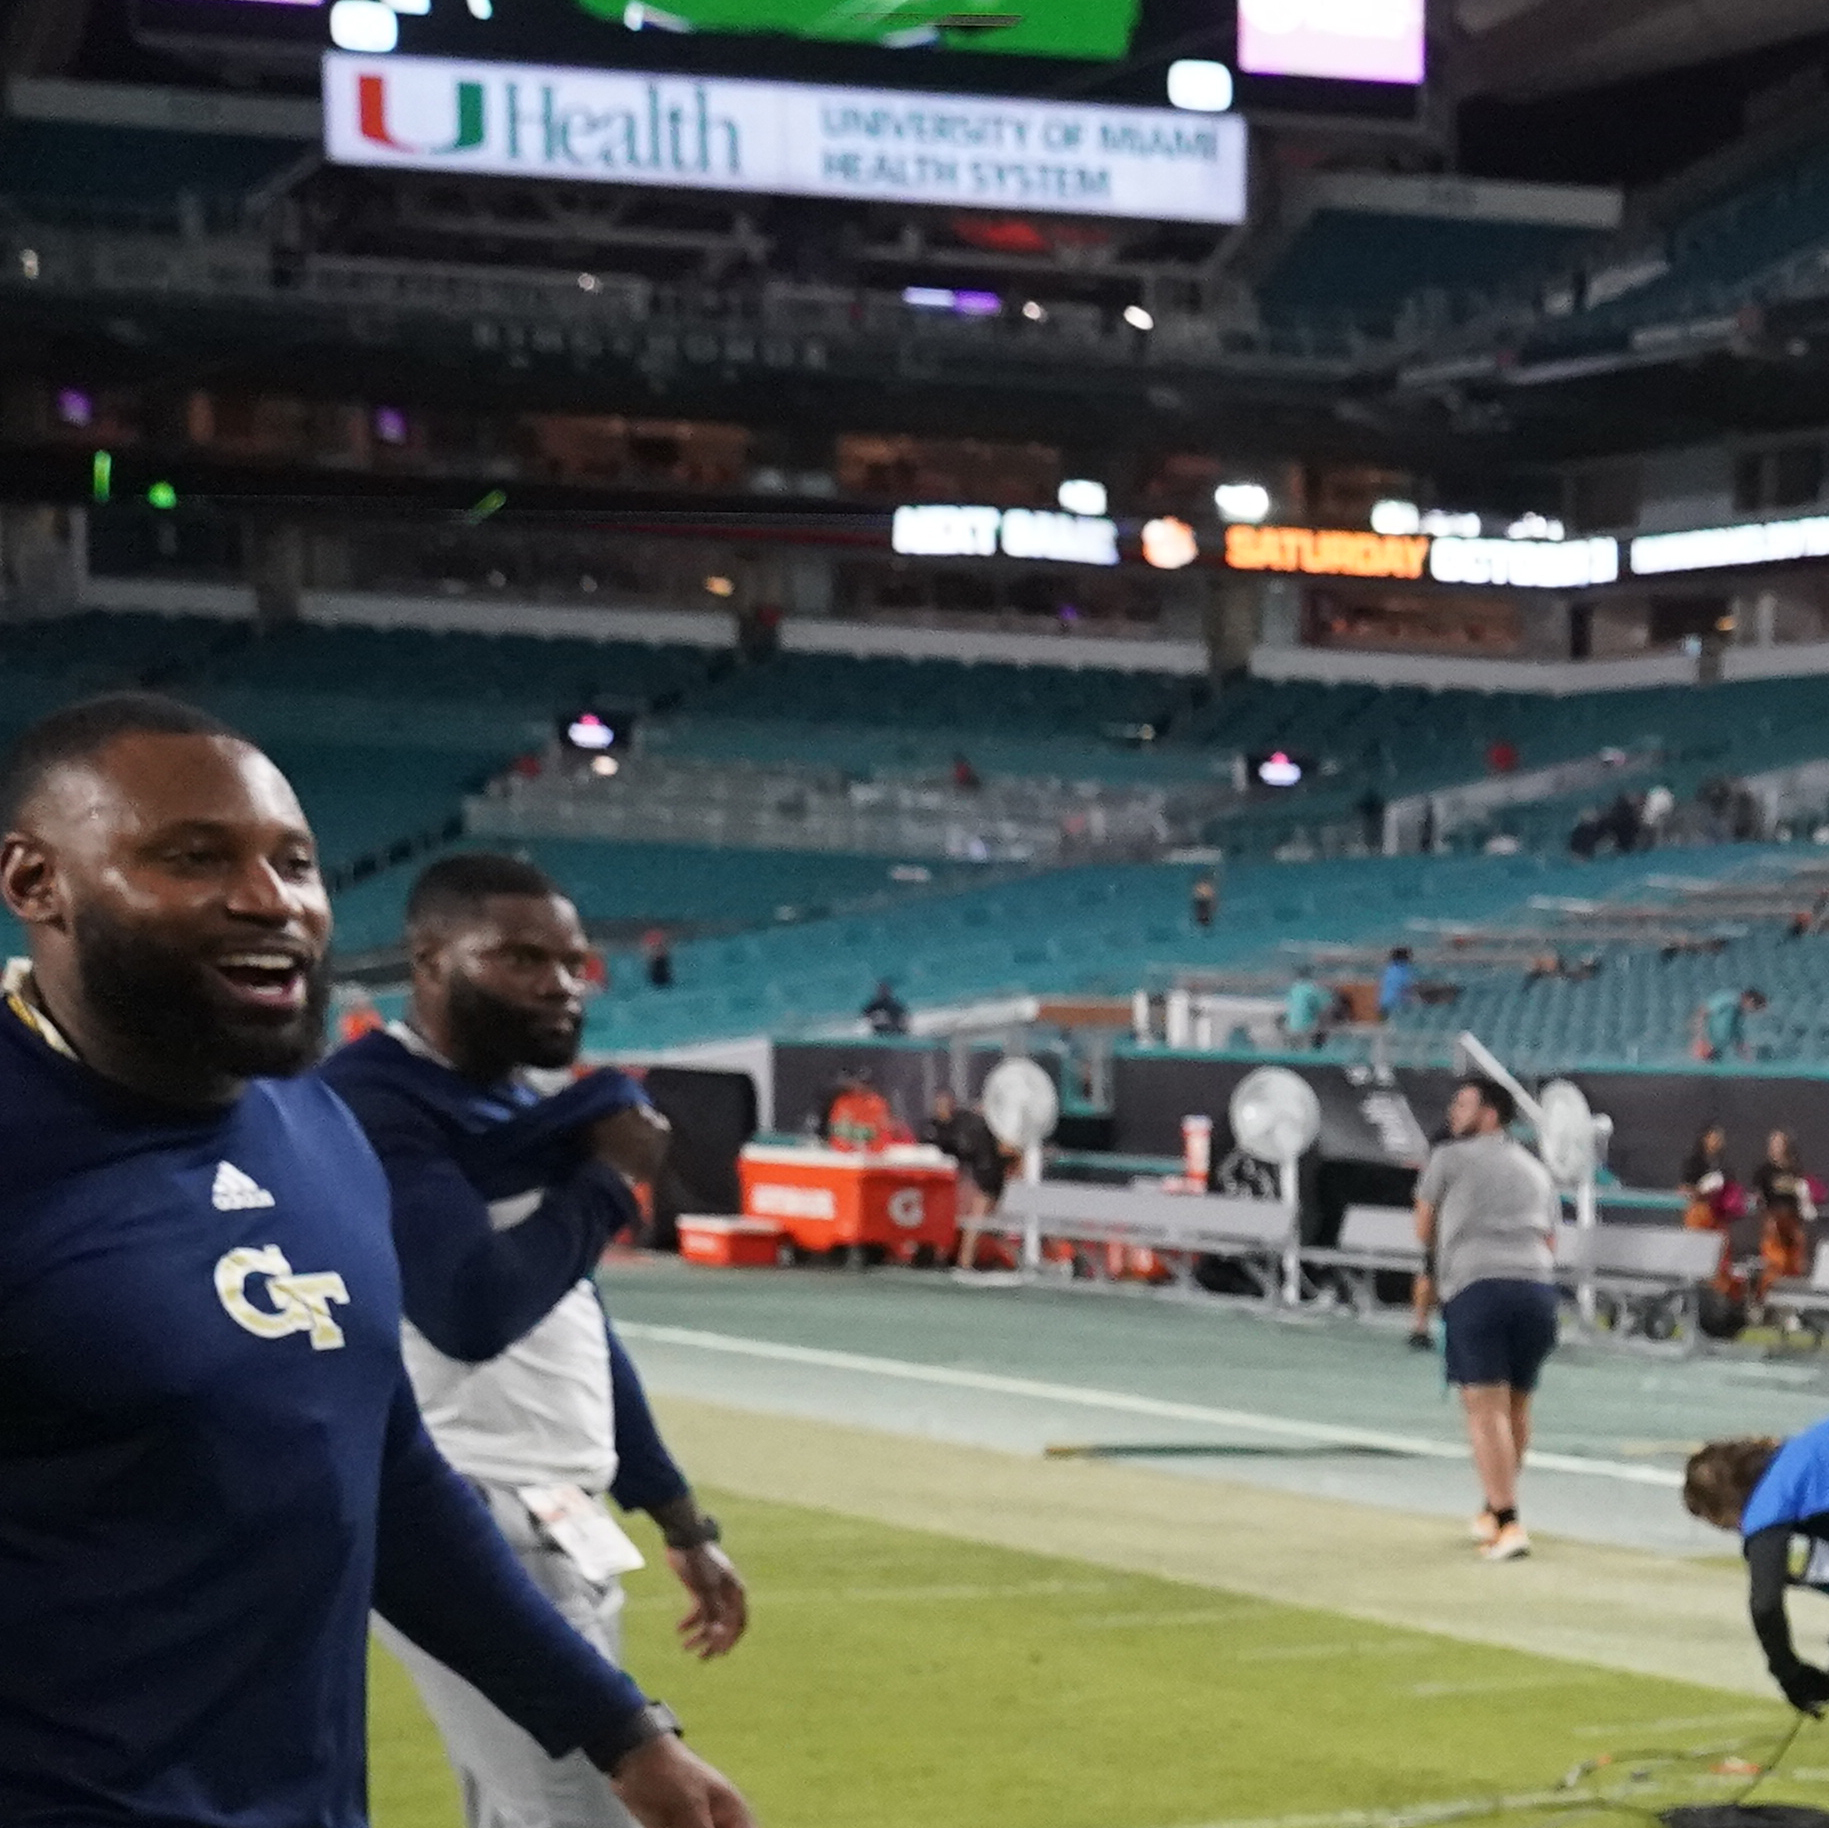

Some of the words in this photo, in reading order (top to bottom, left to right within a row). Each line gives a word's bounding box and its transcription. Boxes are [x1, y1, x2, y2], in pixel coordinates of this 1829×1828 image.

[820, 105, 1031, 148] UNIVERSITY
[1042, 111, 1083, 148] OF
[1099, 119, 1218, 162] MIAMI
[821, 148, 960, 186] HEALTH
[968, 159, 1112, 199] SYSTEM
[1224, 525, 1429, 580] SATURDAY
[214, 1243, 350, 1351] GT
